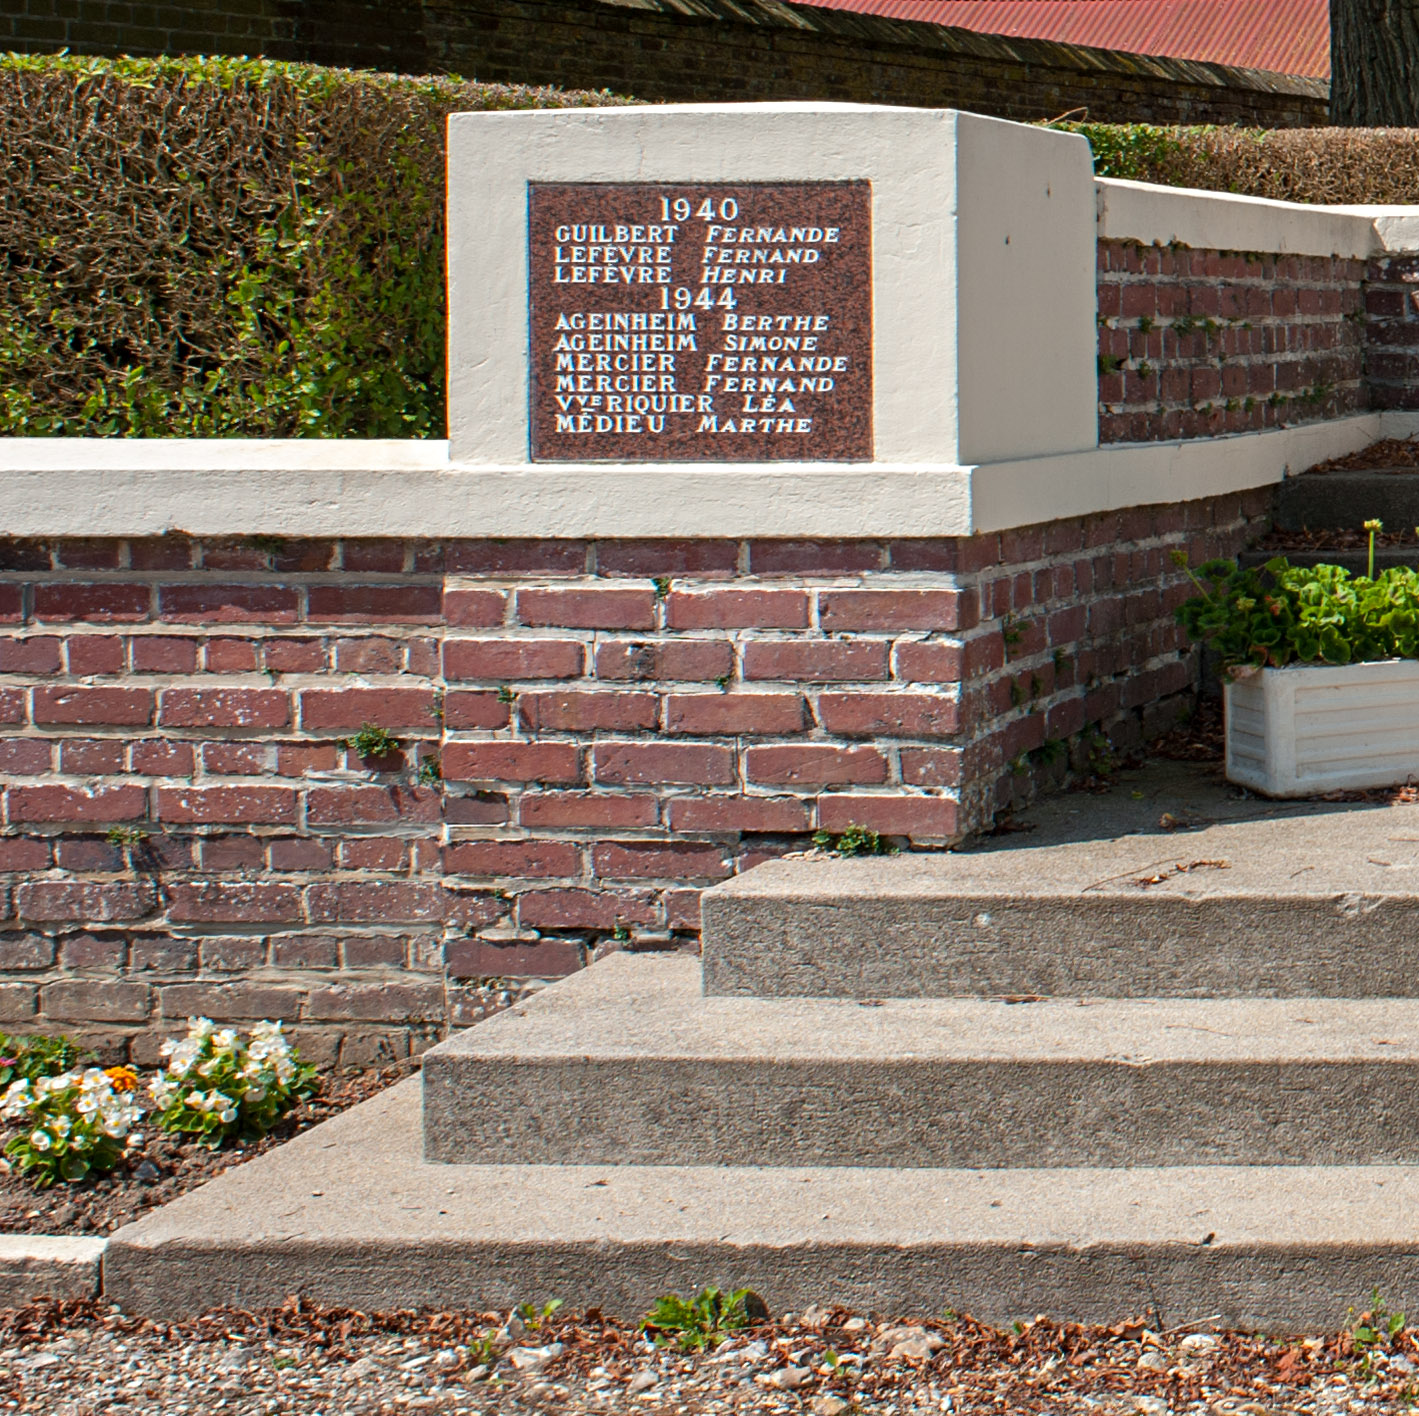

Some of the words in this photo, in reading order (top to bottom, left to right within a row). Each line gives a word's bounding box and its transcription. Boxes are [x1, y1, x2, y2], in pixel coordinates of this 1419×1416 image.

[660, 196, 739, 222] 1940
[554, 224, 679, 244] GUILBERT
[659, 285, 738, 310] 1944
[554, 312, 697, 332] AGEINHEIM
[552, 334, 698, 352] AGEINHEIM
[554, 354, 676, 372] MERCIER
[554, 374, 677, 393] MERCIER
[607, 394, 715, 415] RIQUIER
